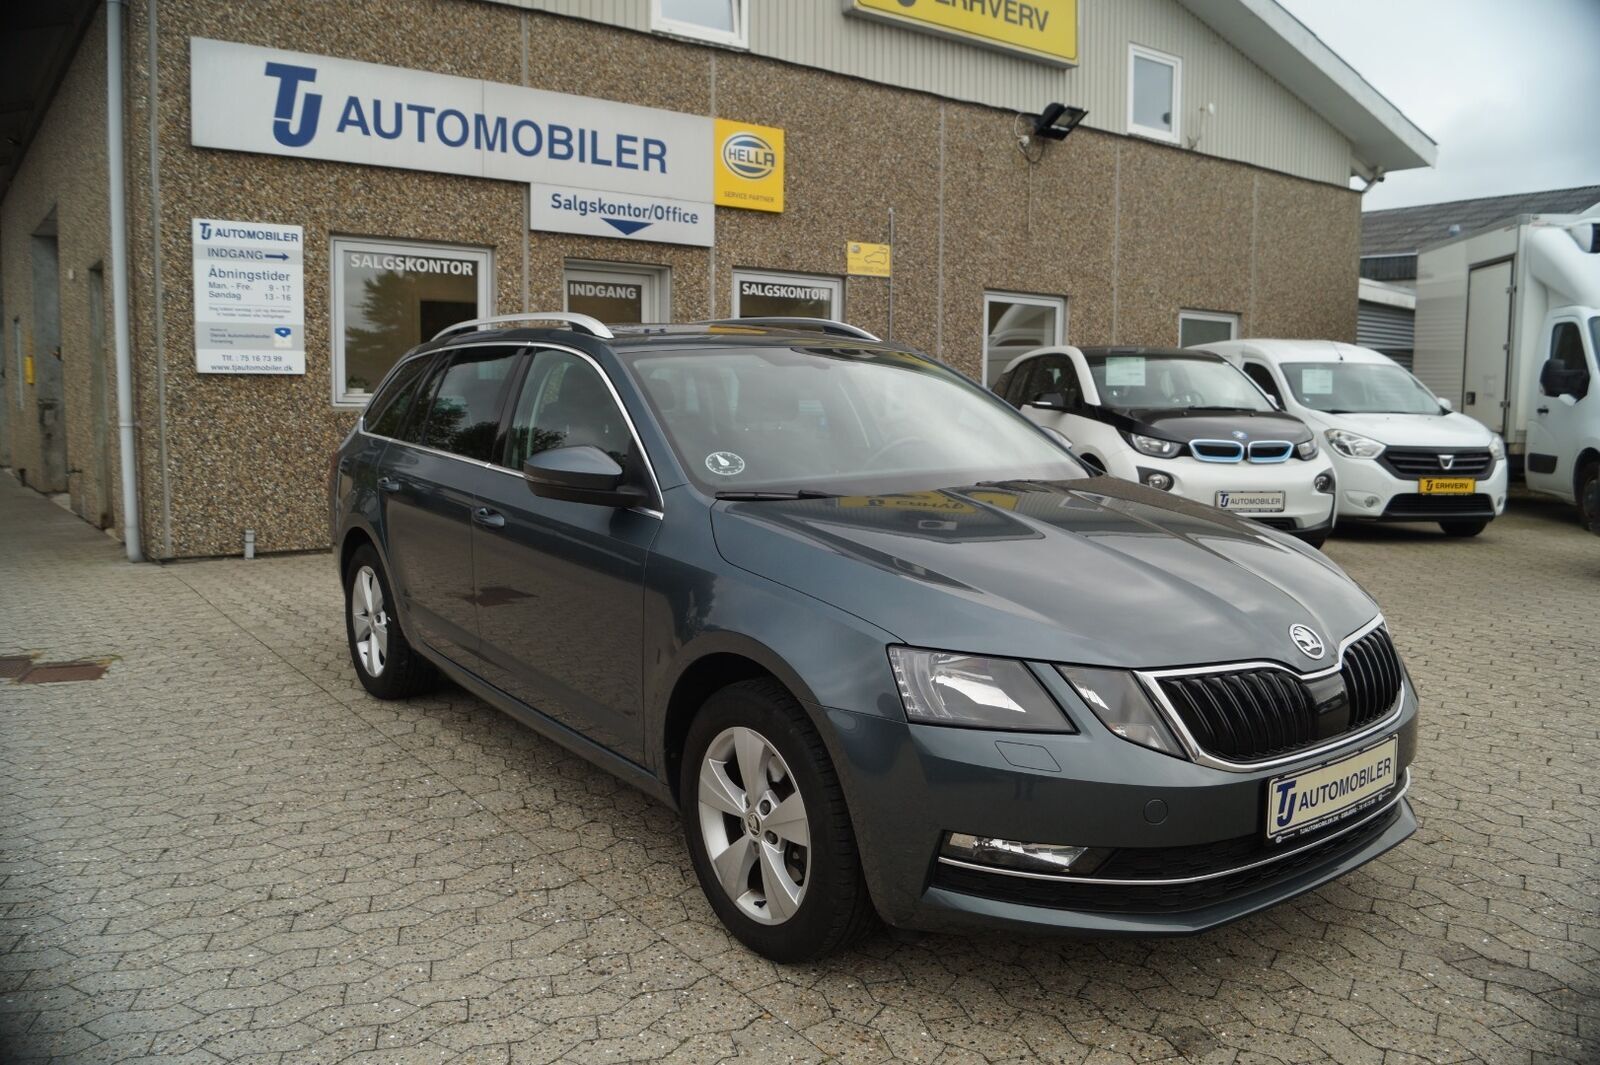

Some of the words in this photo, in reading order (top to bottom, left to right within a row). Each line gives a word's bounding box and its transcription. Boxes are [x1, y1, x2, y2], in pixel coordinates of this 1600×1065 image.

[934, 0, 1049, 32] HVERV
[264, 62, 322, 147] TJ
[336, 96, 667, 174] AUTOMOBILER
[728, 148, 775, 167] HELLA
[724, 191, 747, 200] SERVICE
[749, 194, 774, 203] PARTNER
[551, 193, 699, 225] Salgskontor/Office
[200, 223, 212, 240] TJ
[215, 228, 298, 242] AUTOMOBILER
[207, 248, 263, 260] INDGANG
[208, 265, 290, 282] Åbningstider
[350, 254, 473, 276] SALGSKONTOR
[208, 282, 228, 290] Man.
[570, 283, 636, 299] INDGANG
[742, 283, 829, 301] SALGSKONTOR
[209, 290, 242, 301] Søndag
[211, 364, 293, 373] www.tjautomobiler.dk
[1276, 780, 1297, 827] TJ
[1299, 757, 1391, 812] AUTOMOBILER
